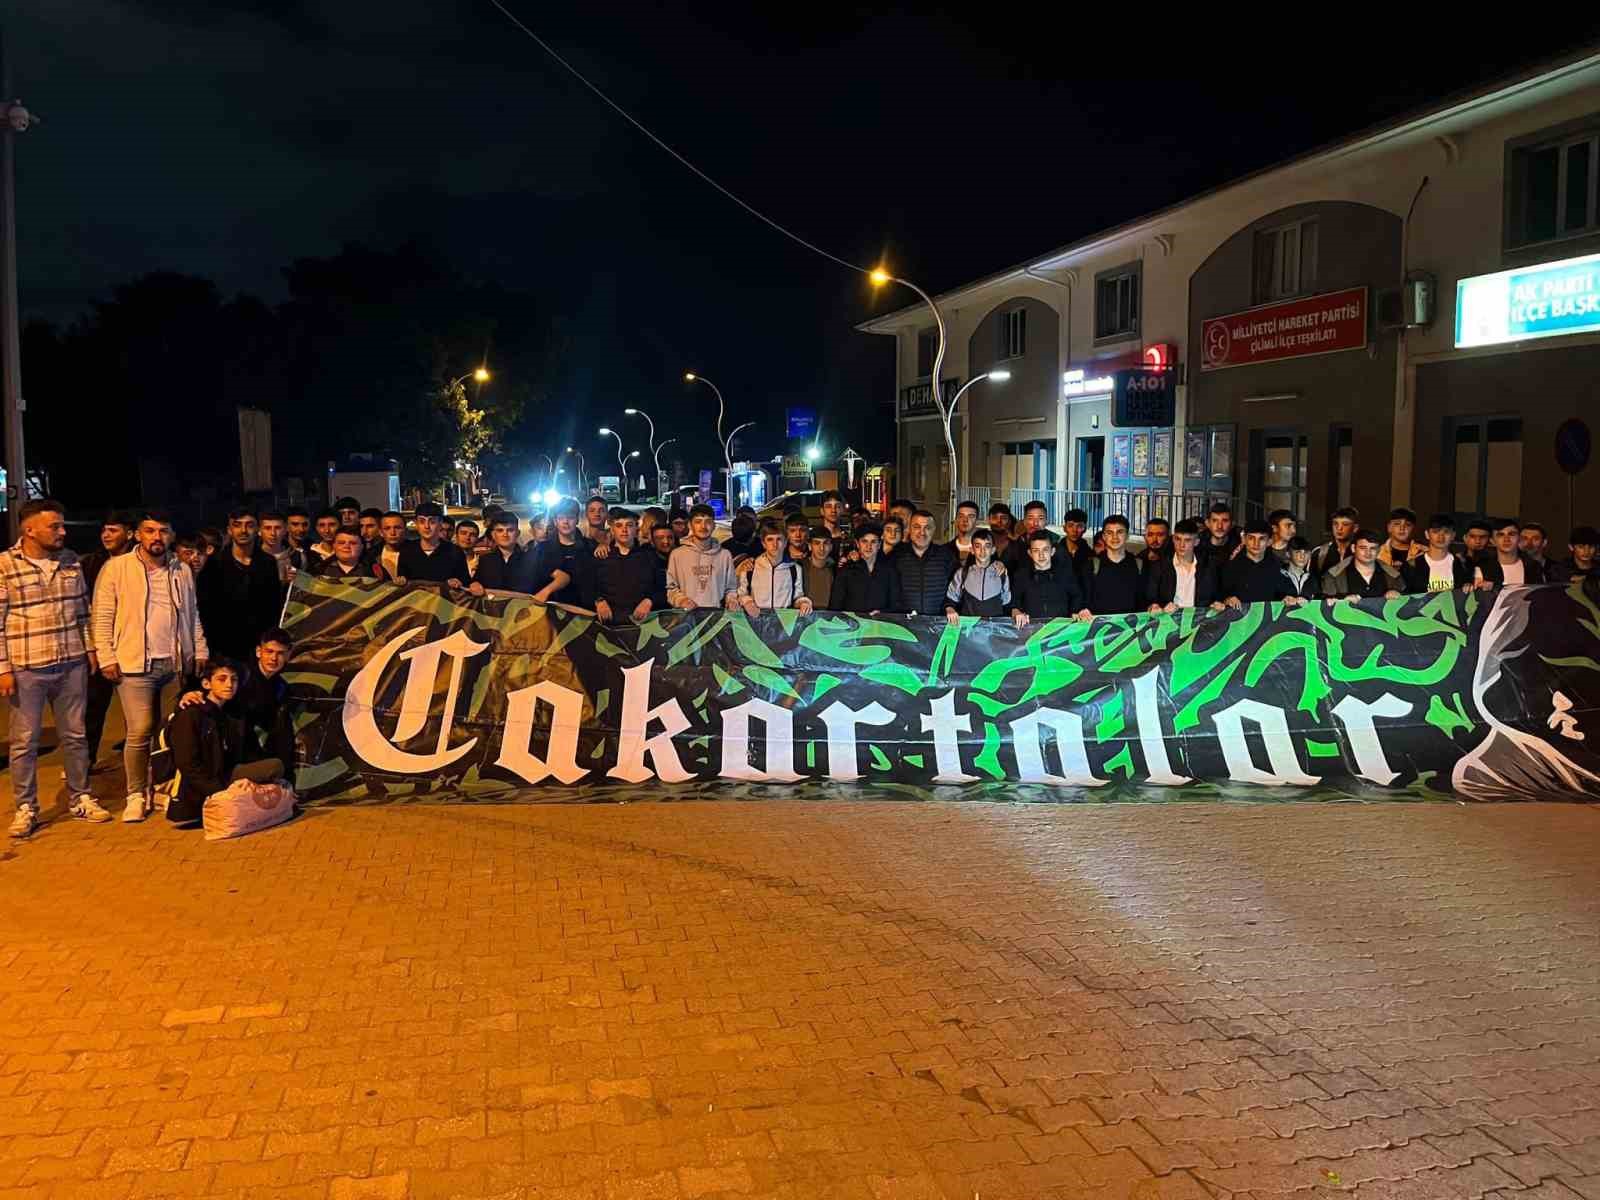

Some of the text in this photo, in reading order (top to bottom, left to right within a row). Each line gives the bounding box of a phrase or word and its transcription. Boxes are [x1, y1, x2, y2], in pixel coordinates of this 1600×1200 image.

[1513, 284, 1536, 301] AK
[1278, 312, 1320, 331] HAREKET
[1321, 302, 1360, 323] PARTİSİ
[1279, 334, 1295, 349] İLÇE
[1127, 376, 1166, 390] A-101
[342, 625, 1415, 786] Cakartalar
